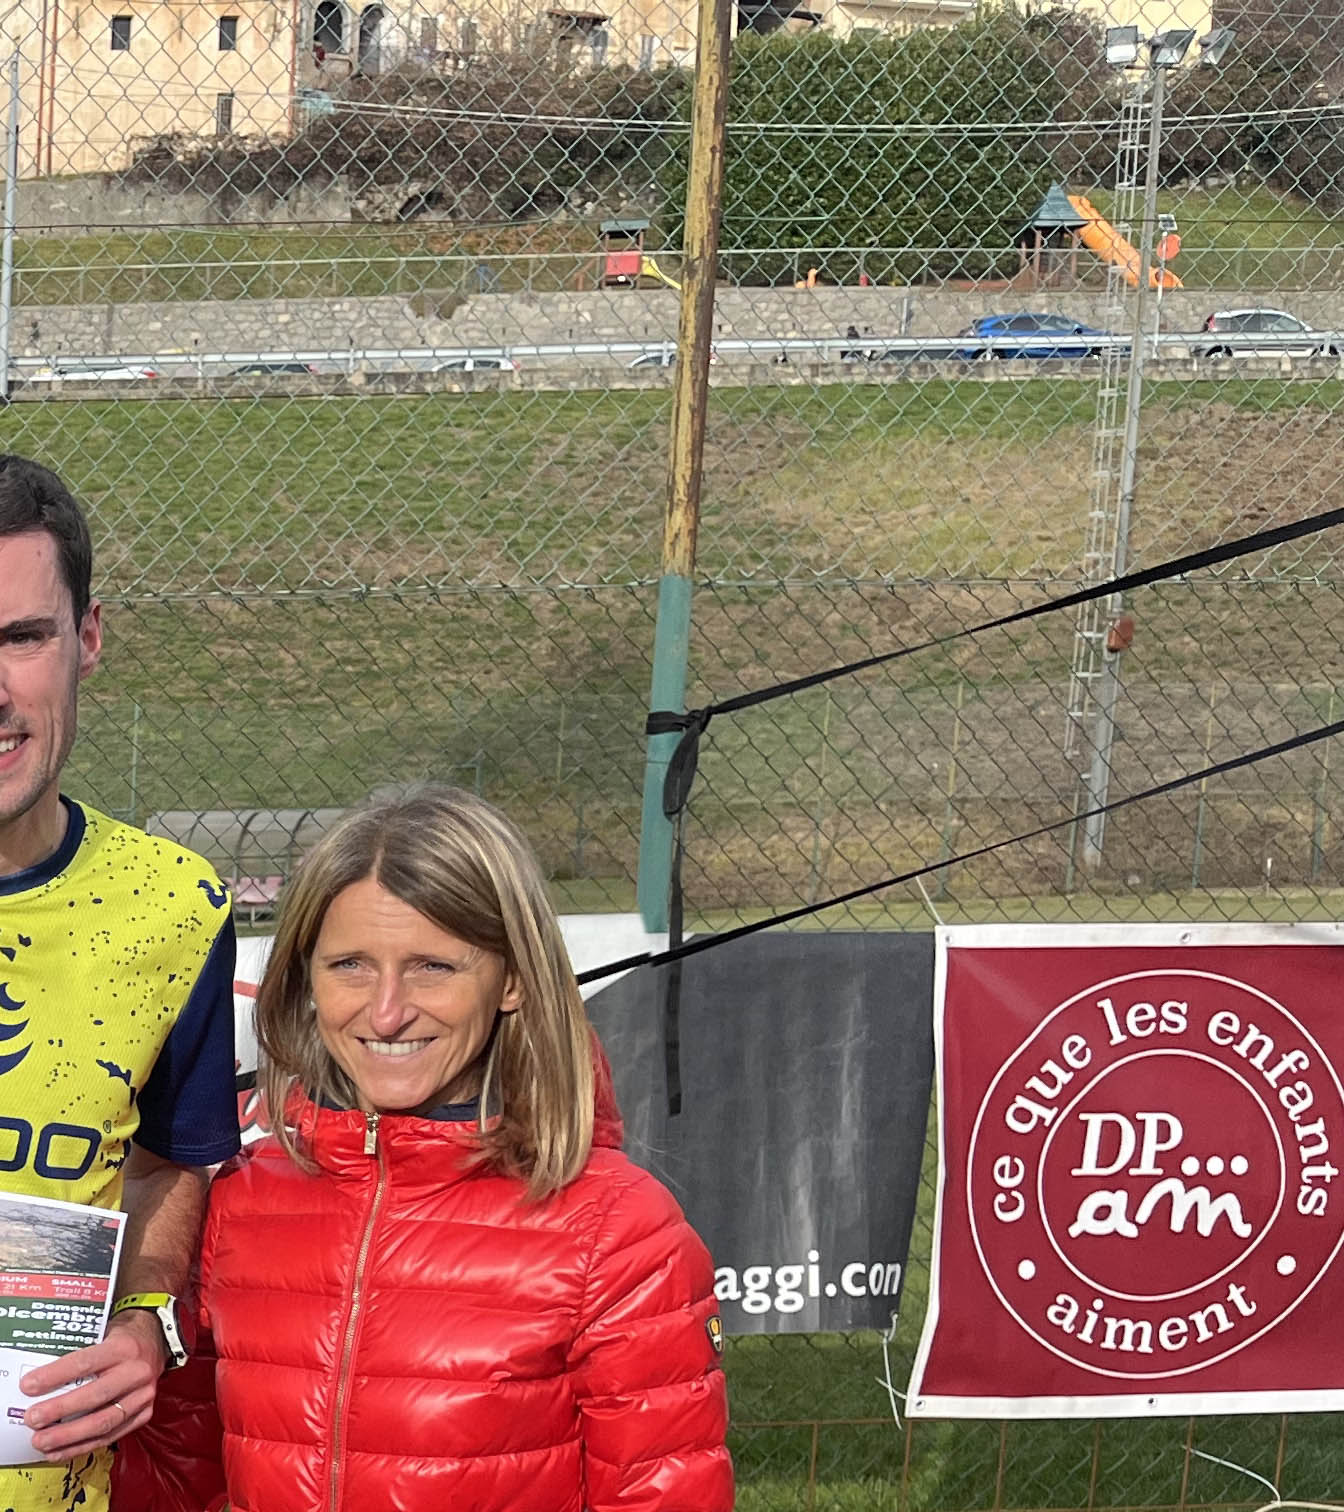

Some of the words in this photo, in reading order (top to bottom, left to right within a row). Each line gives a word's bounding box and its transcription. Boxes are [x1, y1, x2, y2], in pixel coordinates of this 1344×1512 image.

[1097, 998, 1188, 1045] les
[1005, 1033, 1092, 1135] que
[1207, 1009, 1339, 1217] enfants
[993, 1154, 1025, 1223] ce
[1068, 1177, 1252, 1238] am
[51, 1279, 95, 1288] SMALL
[1046, 1282, 1257, 1354] aiment
